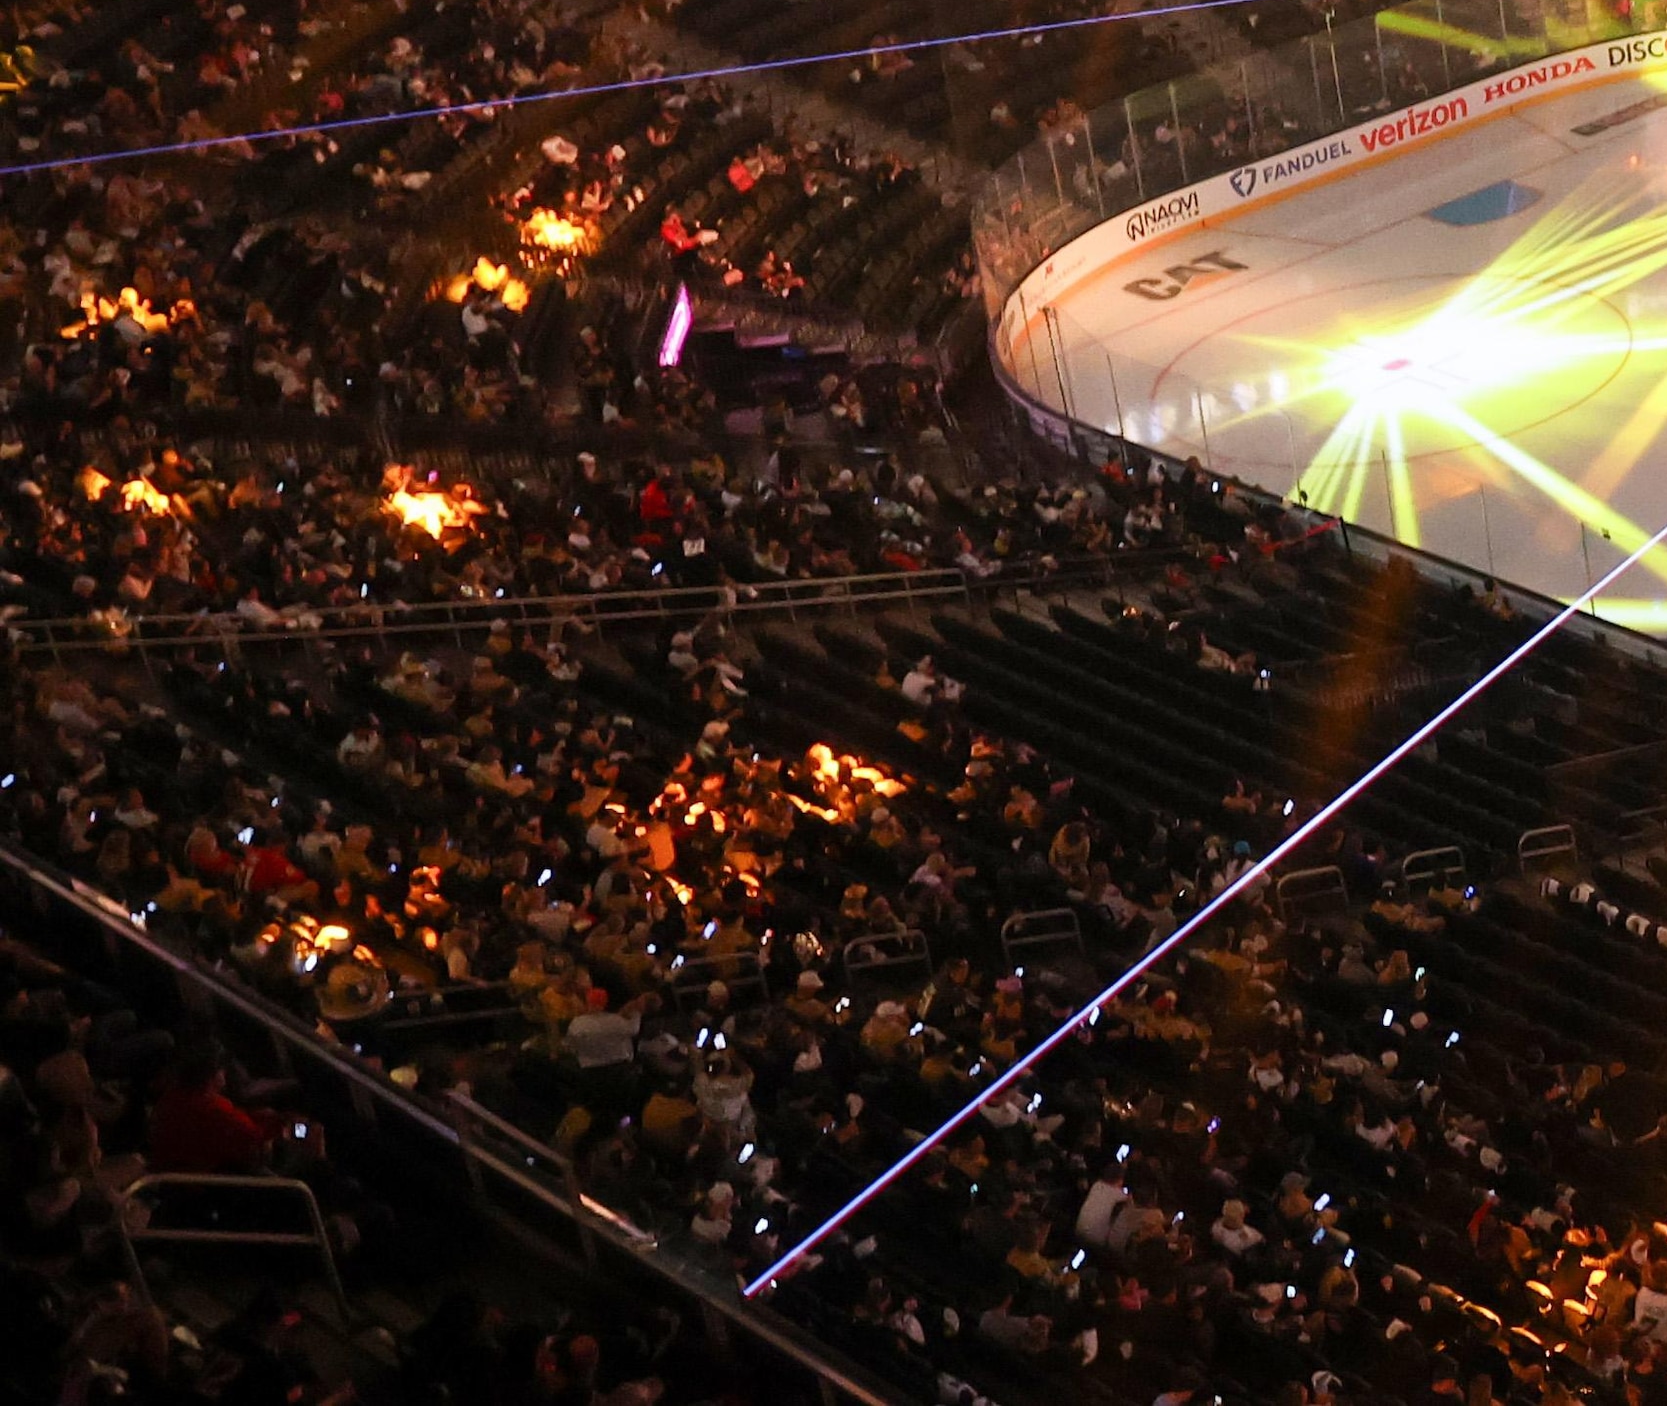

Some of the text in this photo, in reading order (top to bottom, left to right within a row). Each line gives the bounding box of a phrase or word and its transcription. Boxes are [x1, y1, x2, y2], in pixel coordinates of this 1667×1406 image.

[1483, 56, 1595, 104] HONDA
[1360, 97, 1468, 152] verizon
[1263, 141, 1351, 184] FANDUEL
[1122, 251, 1249, 300] CAT
